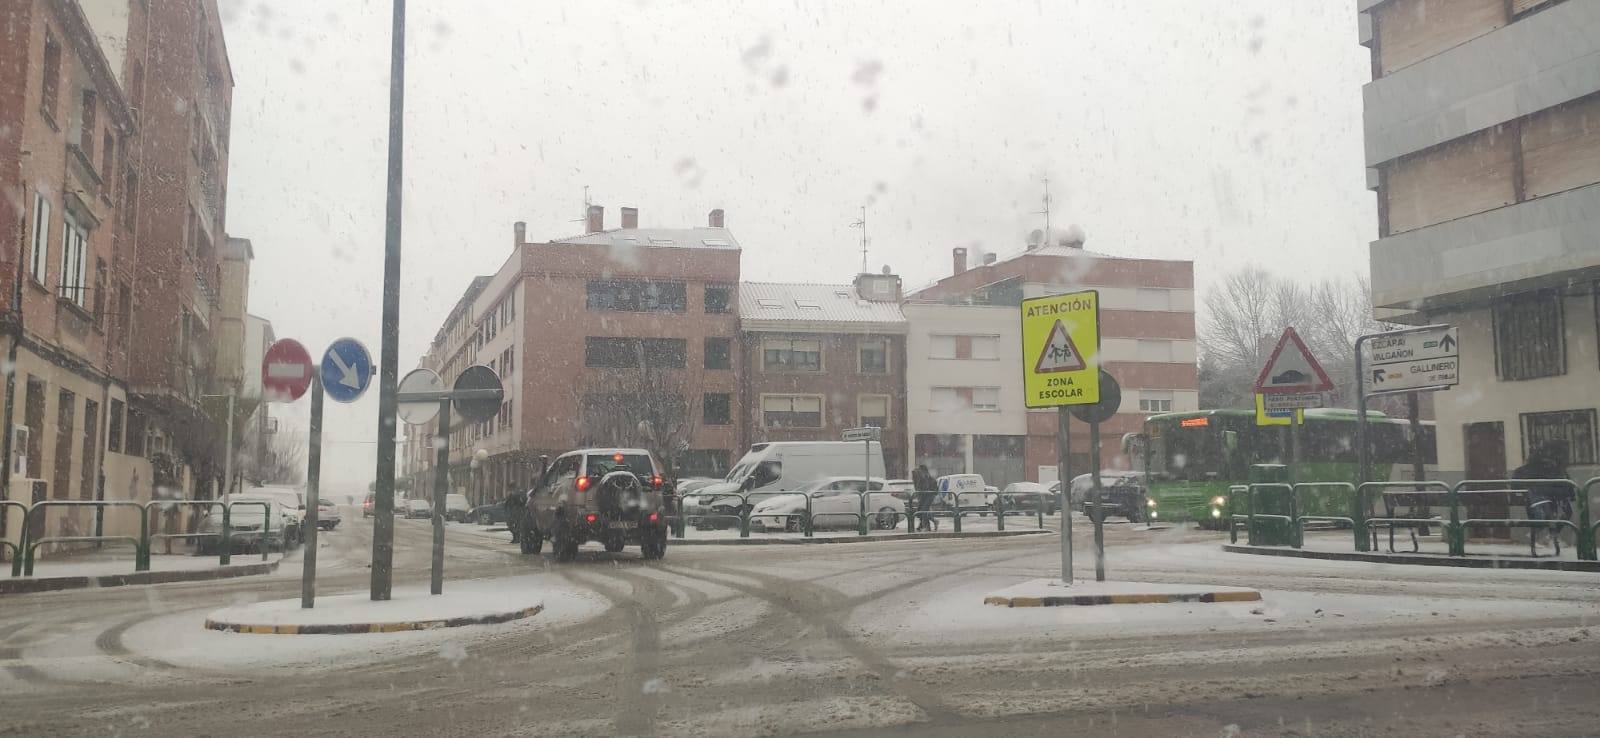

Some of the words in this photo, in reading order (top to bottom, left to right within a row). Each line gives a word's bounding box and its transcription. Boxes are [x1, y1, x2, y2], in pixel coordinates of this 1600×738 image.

[1027, 298, 1091, 318] ATENCIÓN
[1047, 377, 1074, 386] ZONA
[1039, 388, 1083, 399] ESCOLAR
